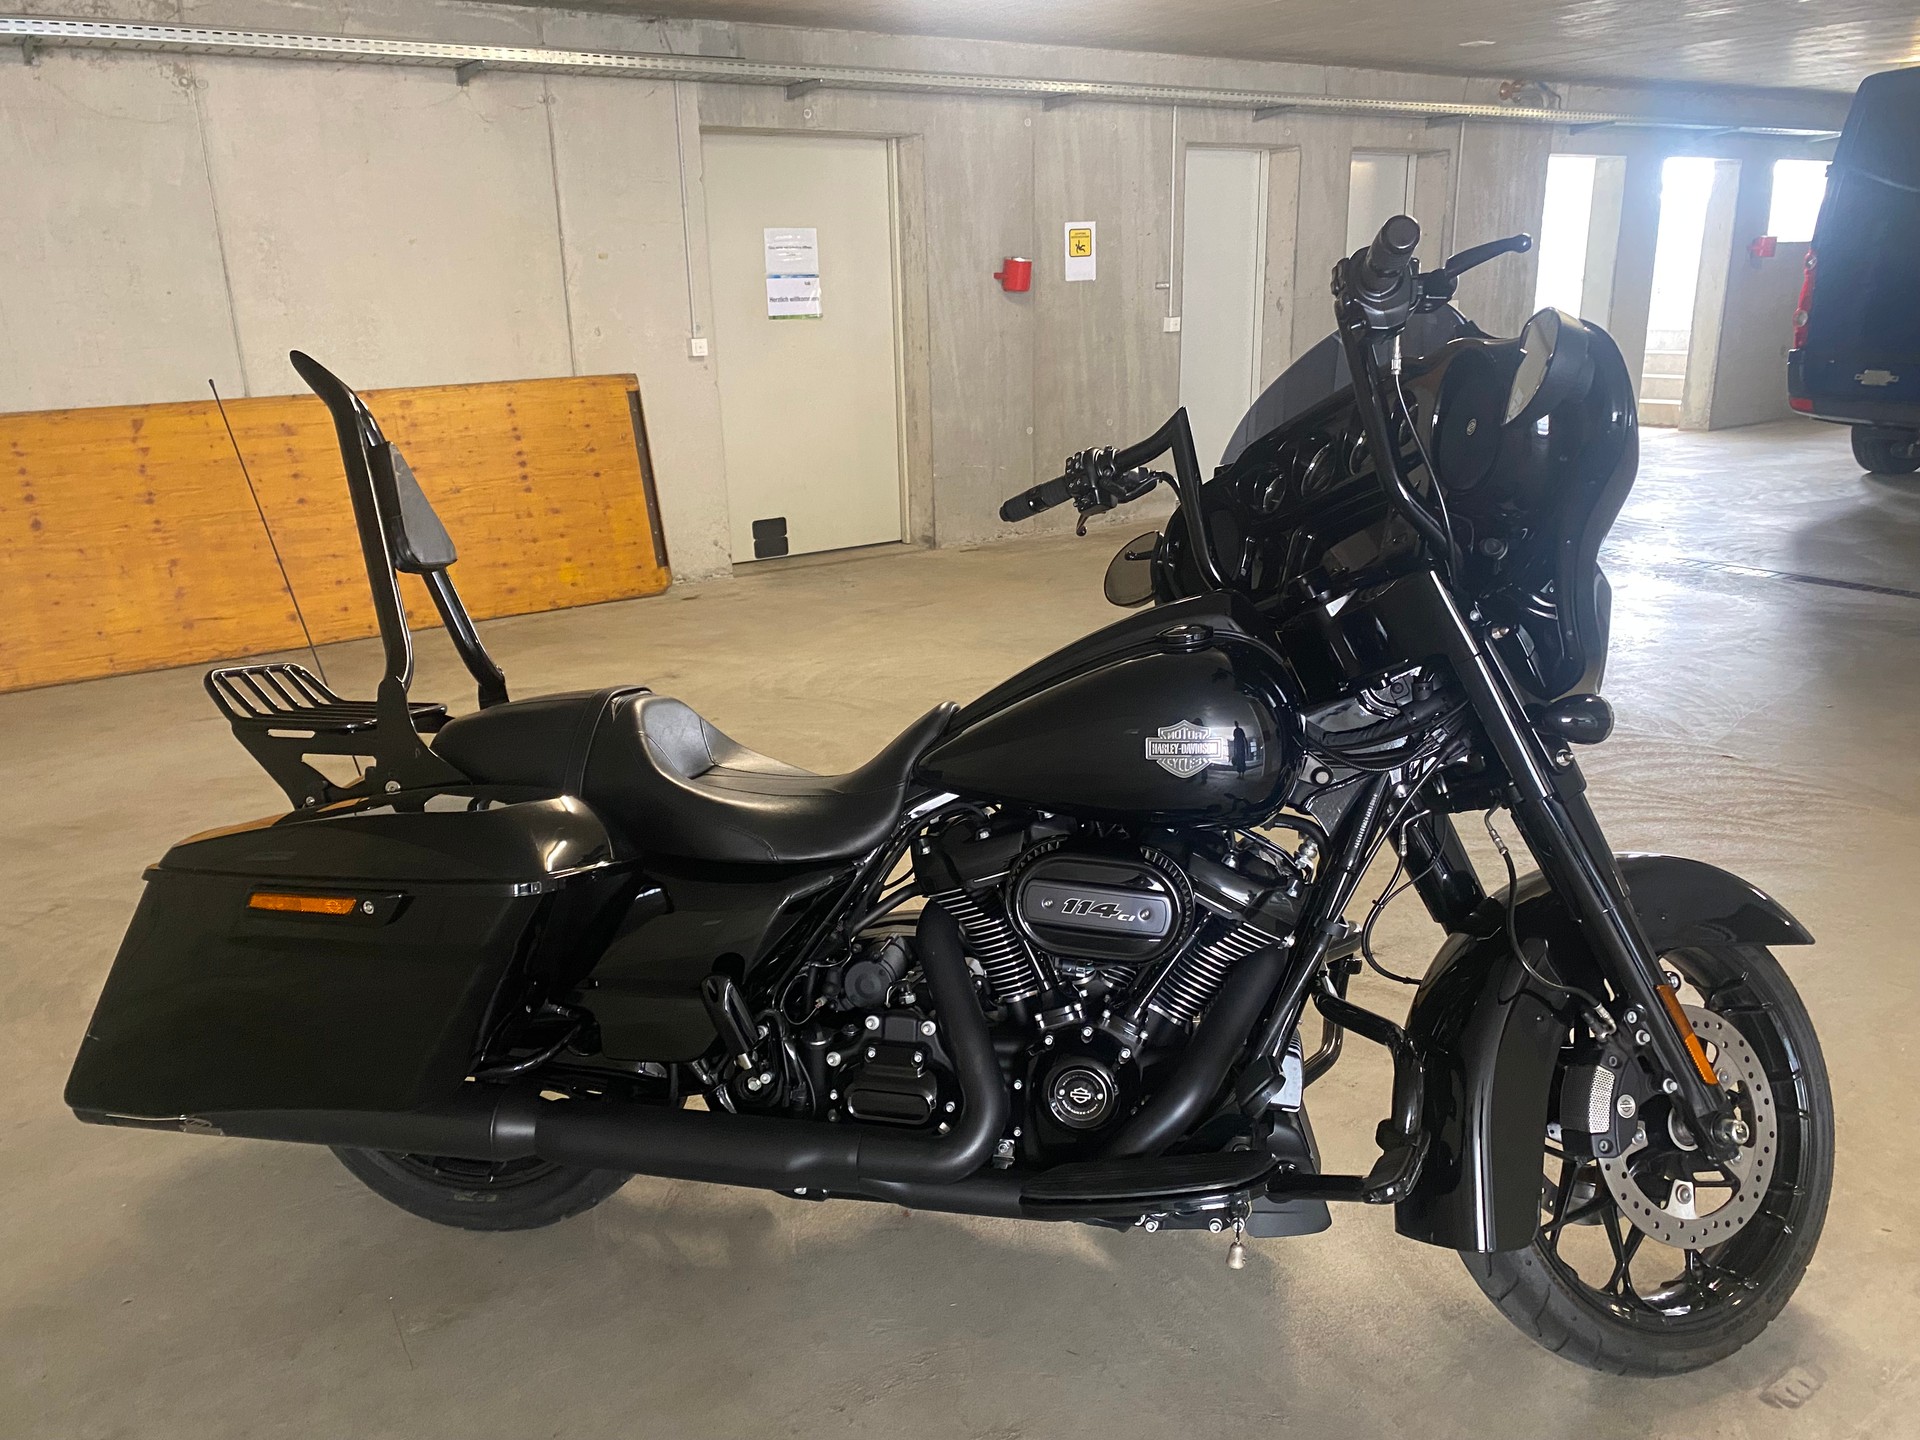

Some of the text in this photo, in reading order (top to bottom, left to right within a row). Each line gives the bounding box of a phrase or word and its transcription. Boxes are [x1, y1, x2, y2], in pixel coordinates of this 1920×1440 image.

[1167, 727, 1202, 740] MOTOR
[1152, 743, 1218, 755] HARLEY-DAVIDS
[1061, 898, 1123, 919] 114
